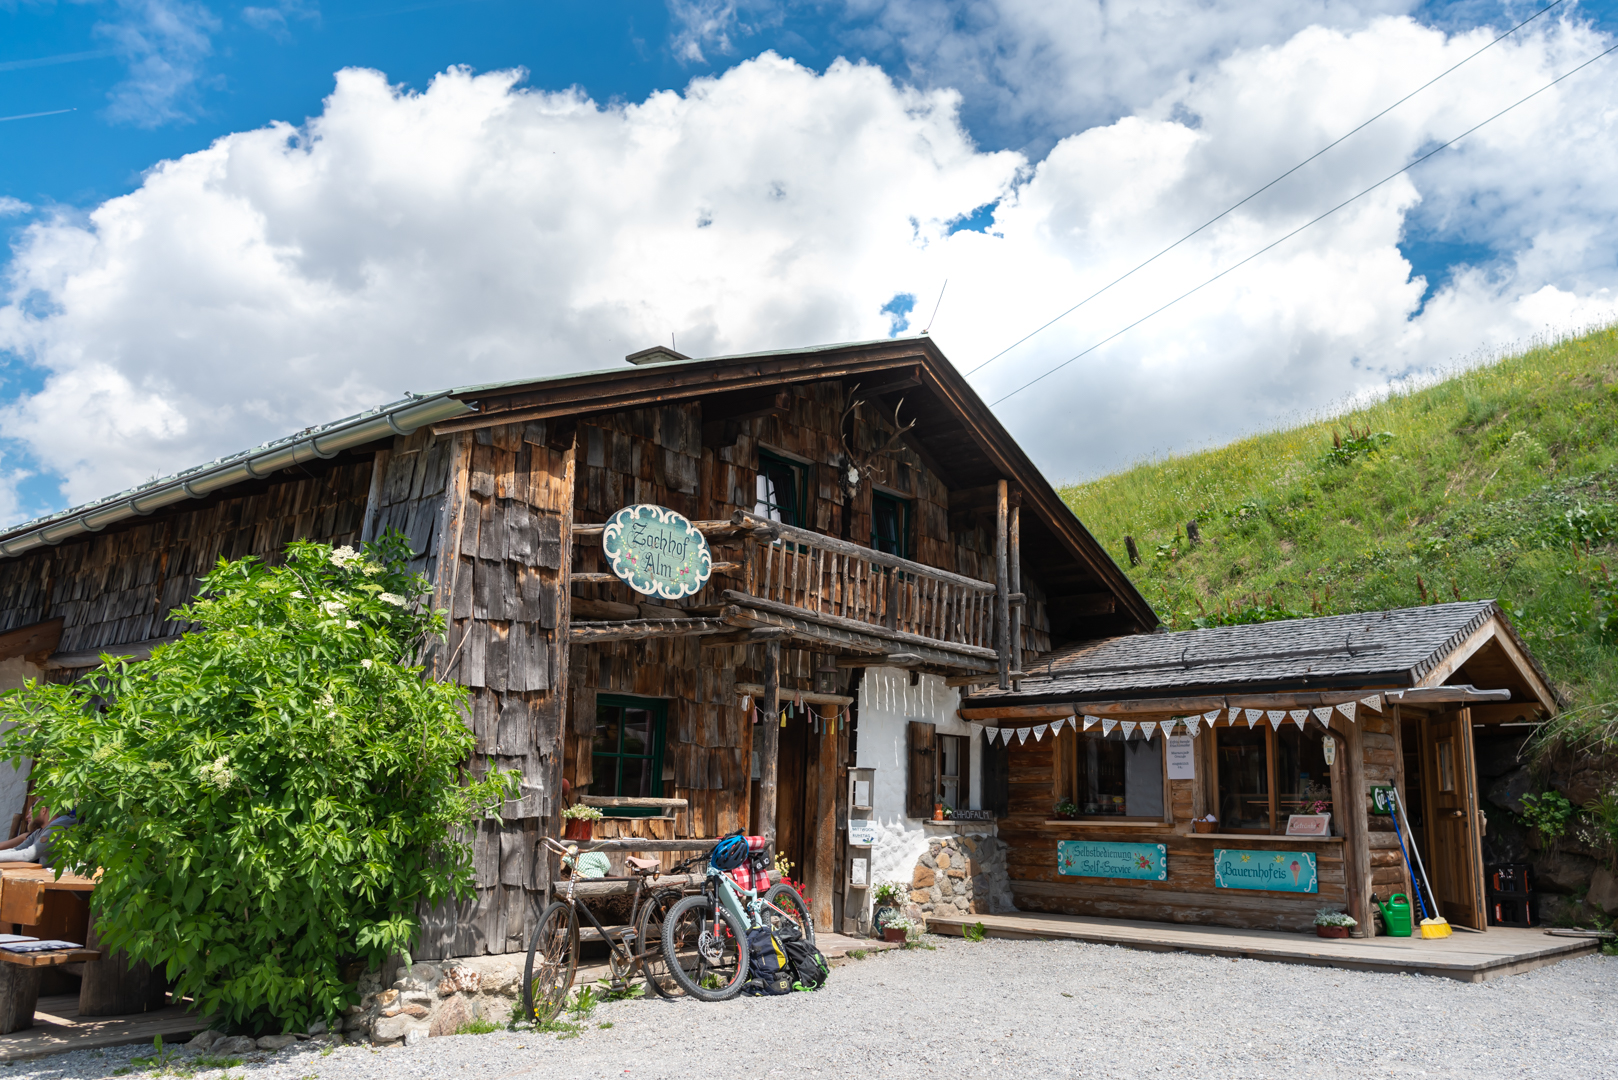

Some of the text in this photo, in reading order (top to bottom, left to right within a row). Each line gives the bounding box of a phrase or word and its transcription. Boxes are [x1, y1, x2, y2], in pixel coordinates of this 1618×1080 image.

[642, 551, 672, 578] Alm
[949, 810, 990, 819] ACHHOFALM
[1072, 844, 1132, 861] Selbstbedienung
[1080, 860, 1131, 875] Self-Service
[1222, 861, 1287, 883] Bauernhofeis
